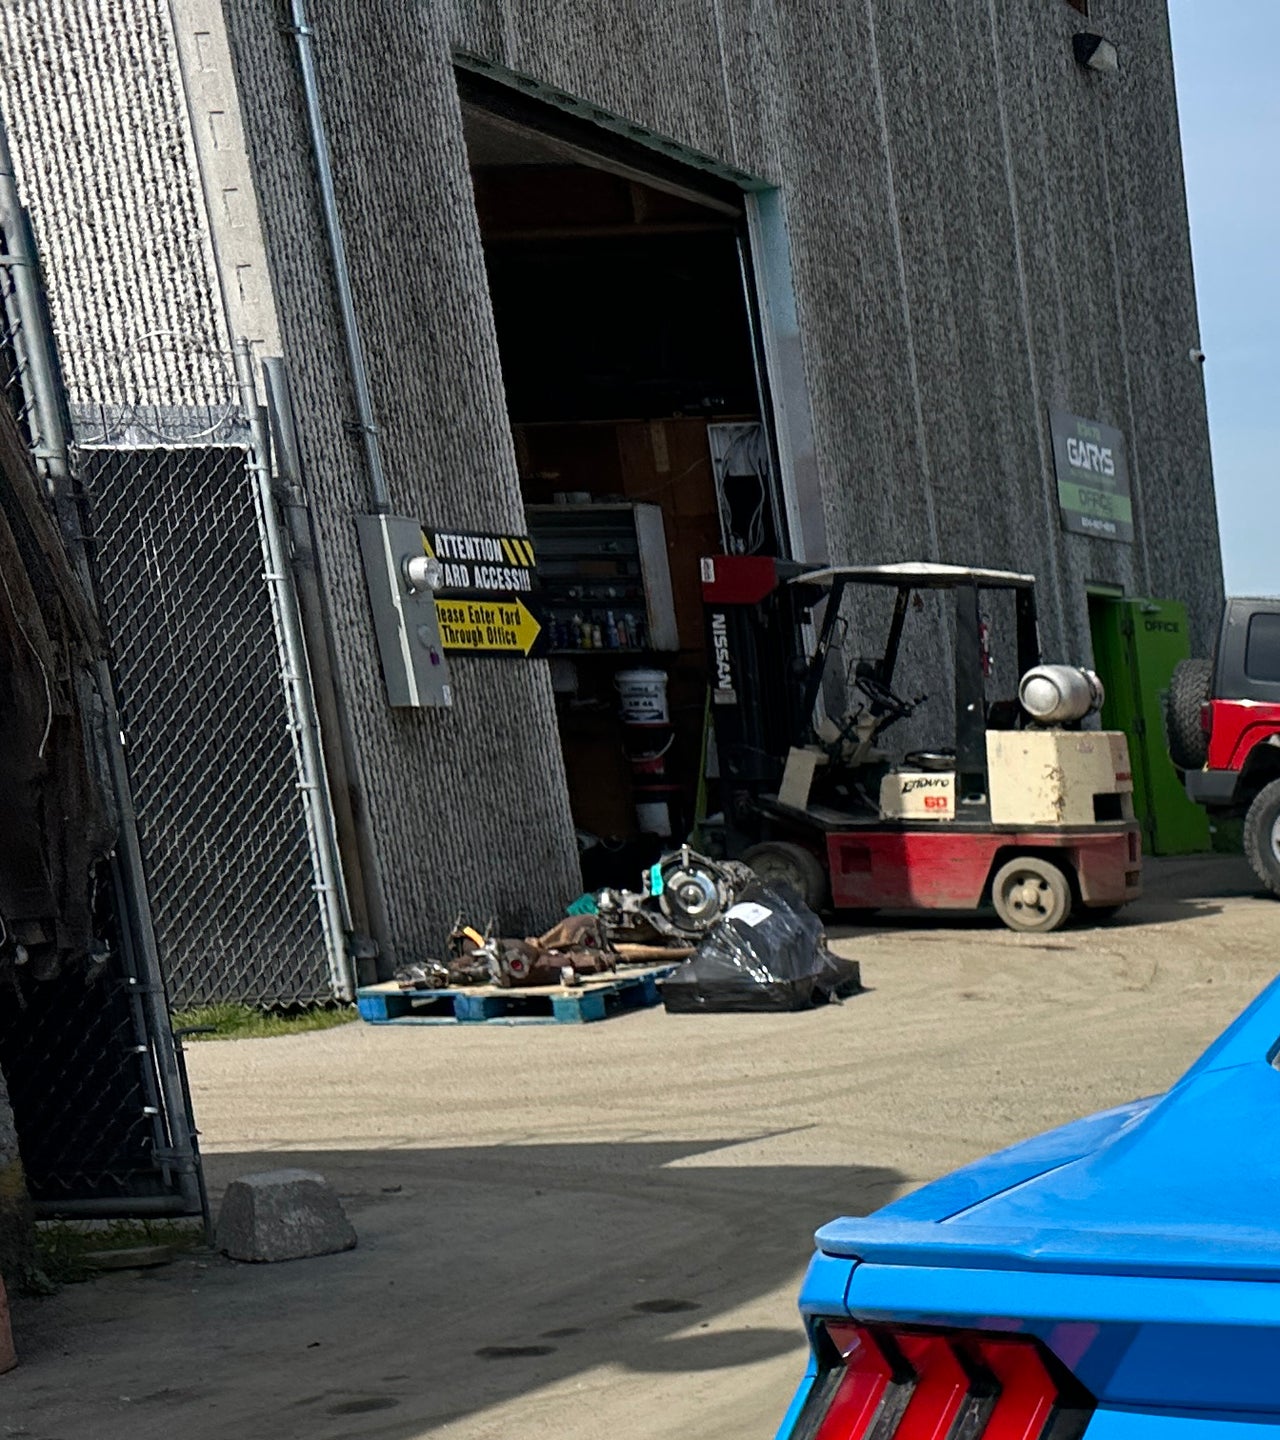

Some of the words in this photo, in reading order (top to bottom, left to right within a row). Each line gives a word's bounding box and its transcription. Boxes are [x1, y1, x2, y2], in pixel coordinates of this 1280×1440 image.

[1067, 438, 1115, 476] GARYS
[434, 533, 503, 562] ATTENTION
[436, 603, 465, 623] lease
[467, 606, 495, 625] Enter
[498, 607, 521, 625] Yard
[1144, 620, 1180, 633] OFFICE
[441, 625, 483, 647] Through
[486, 626, 517, 645] Office
[712, 613, 732, 690] NISSAN
